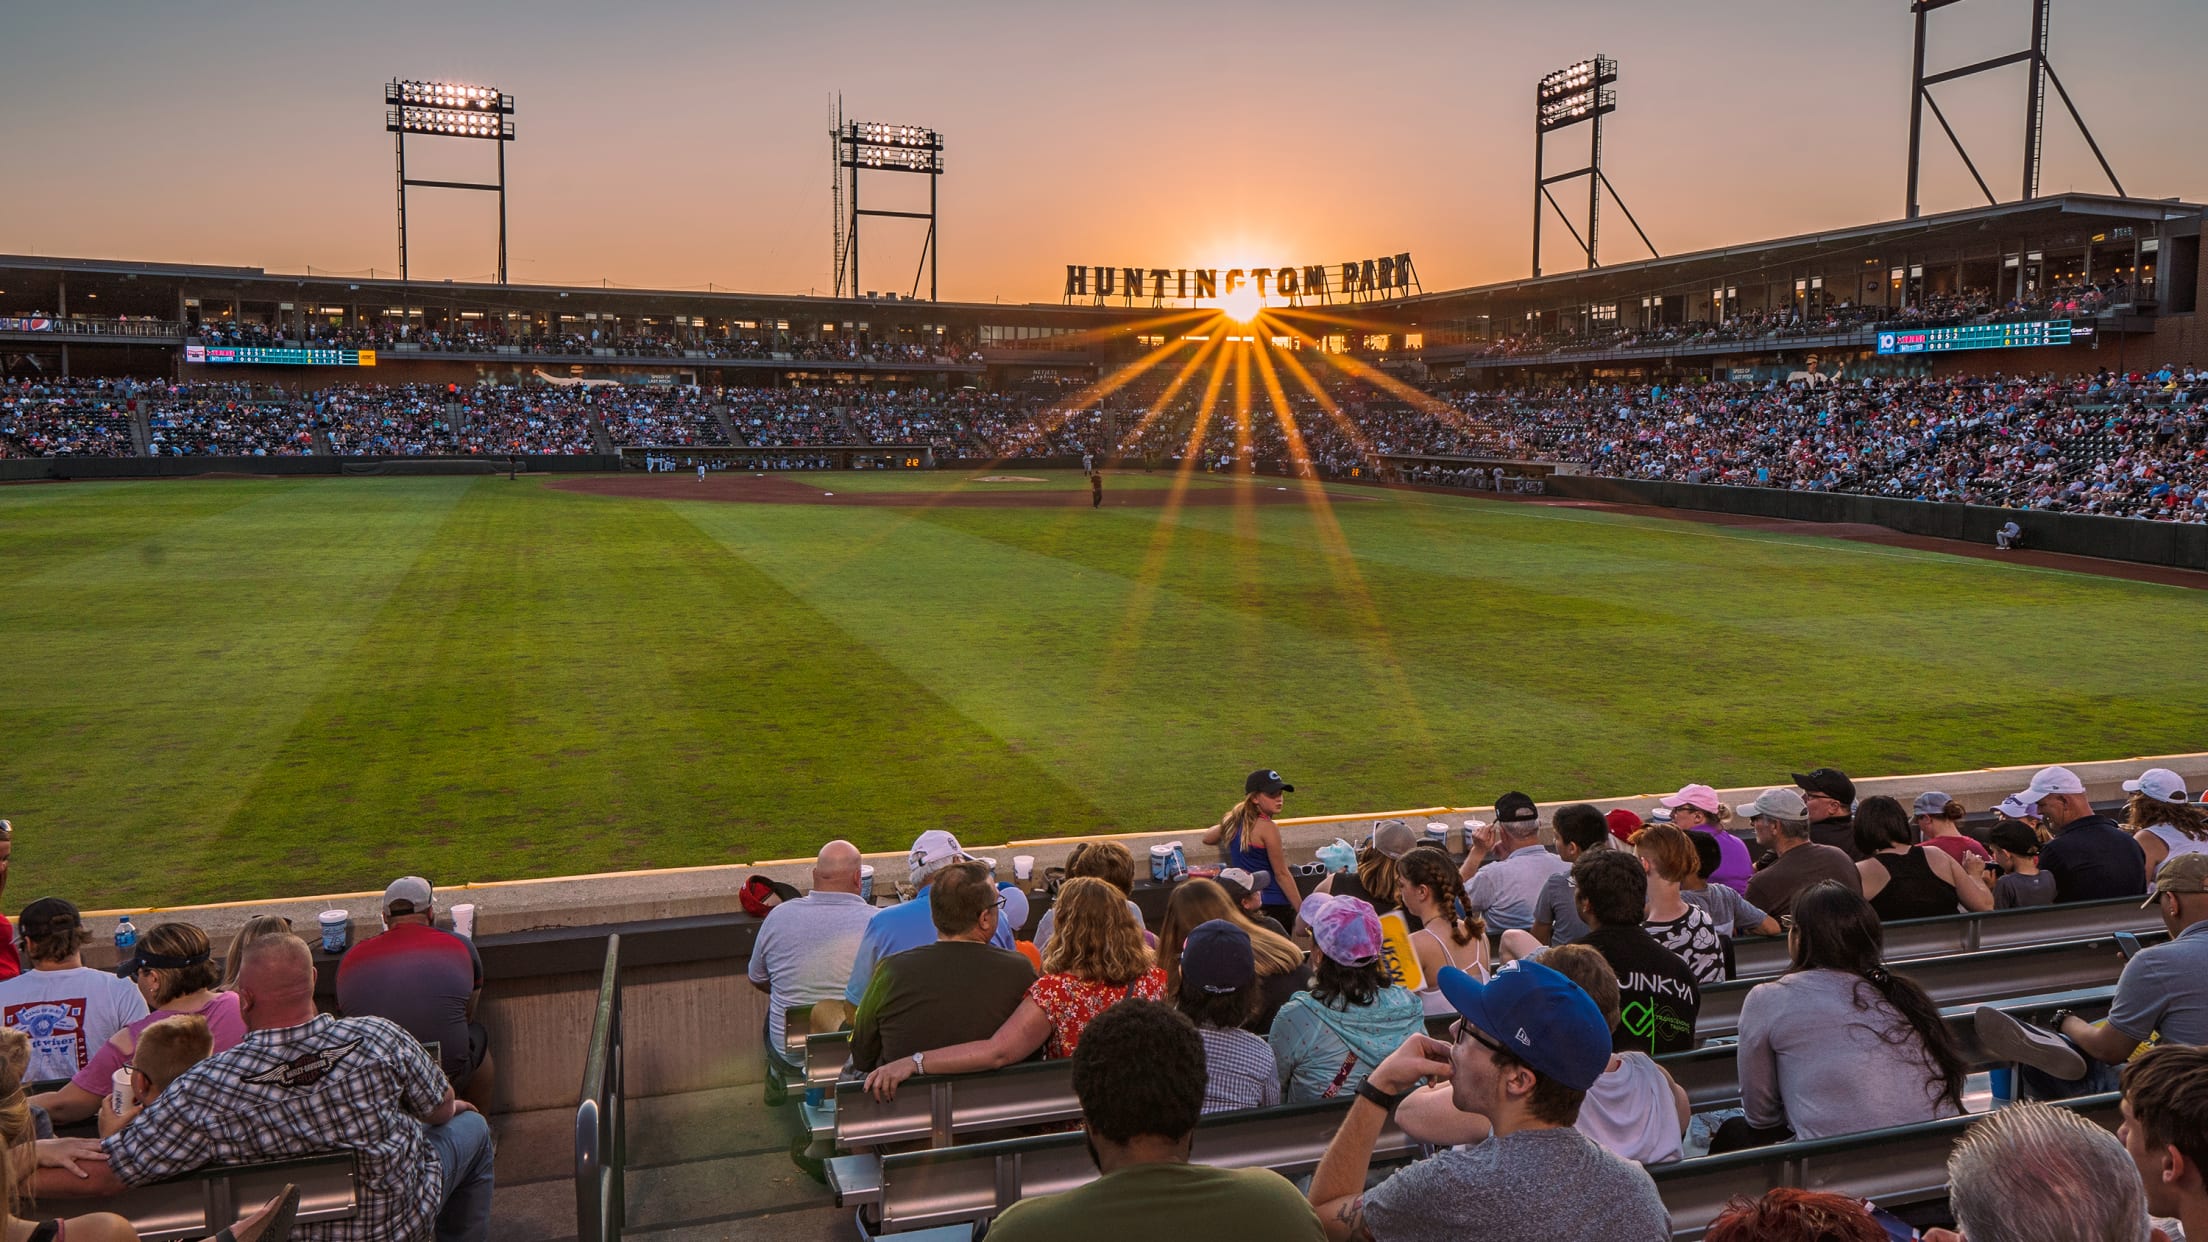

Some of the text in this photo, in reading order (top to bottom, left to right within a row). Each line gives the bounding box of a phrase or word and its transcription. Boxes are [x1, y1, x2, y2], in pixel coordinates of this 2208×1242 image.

[1066, 252, 1411, 298] HUNTINGTON PARK
[1880, 335, 1894, 348] 10
[32, 1038, 75, 1048] ttwiser
